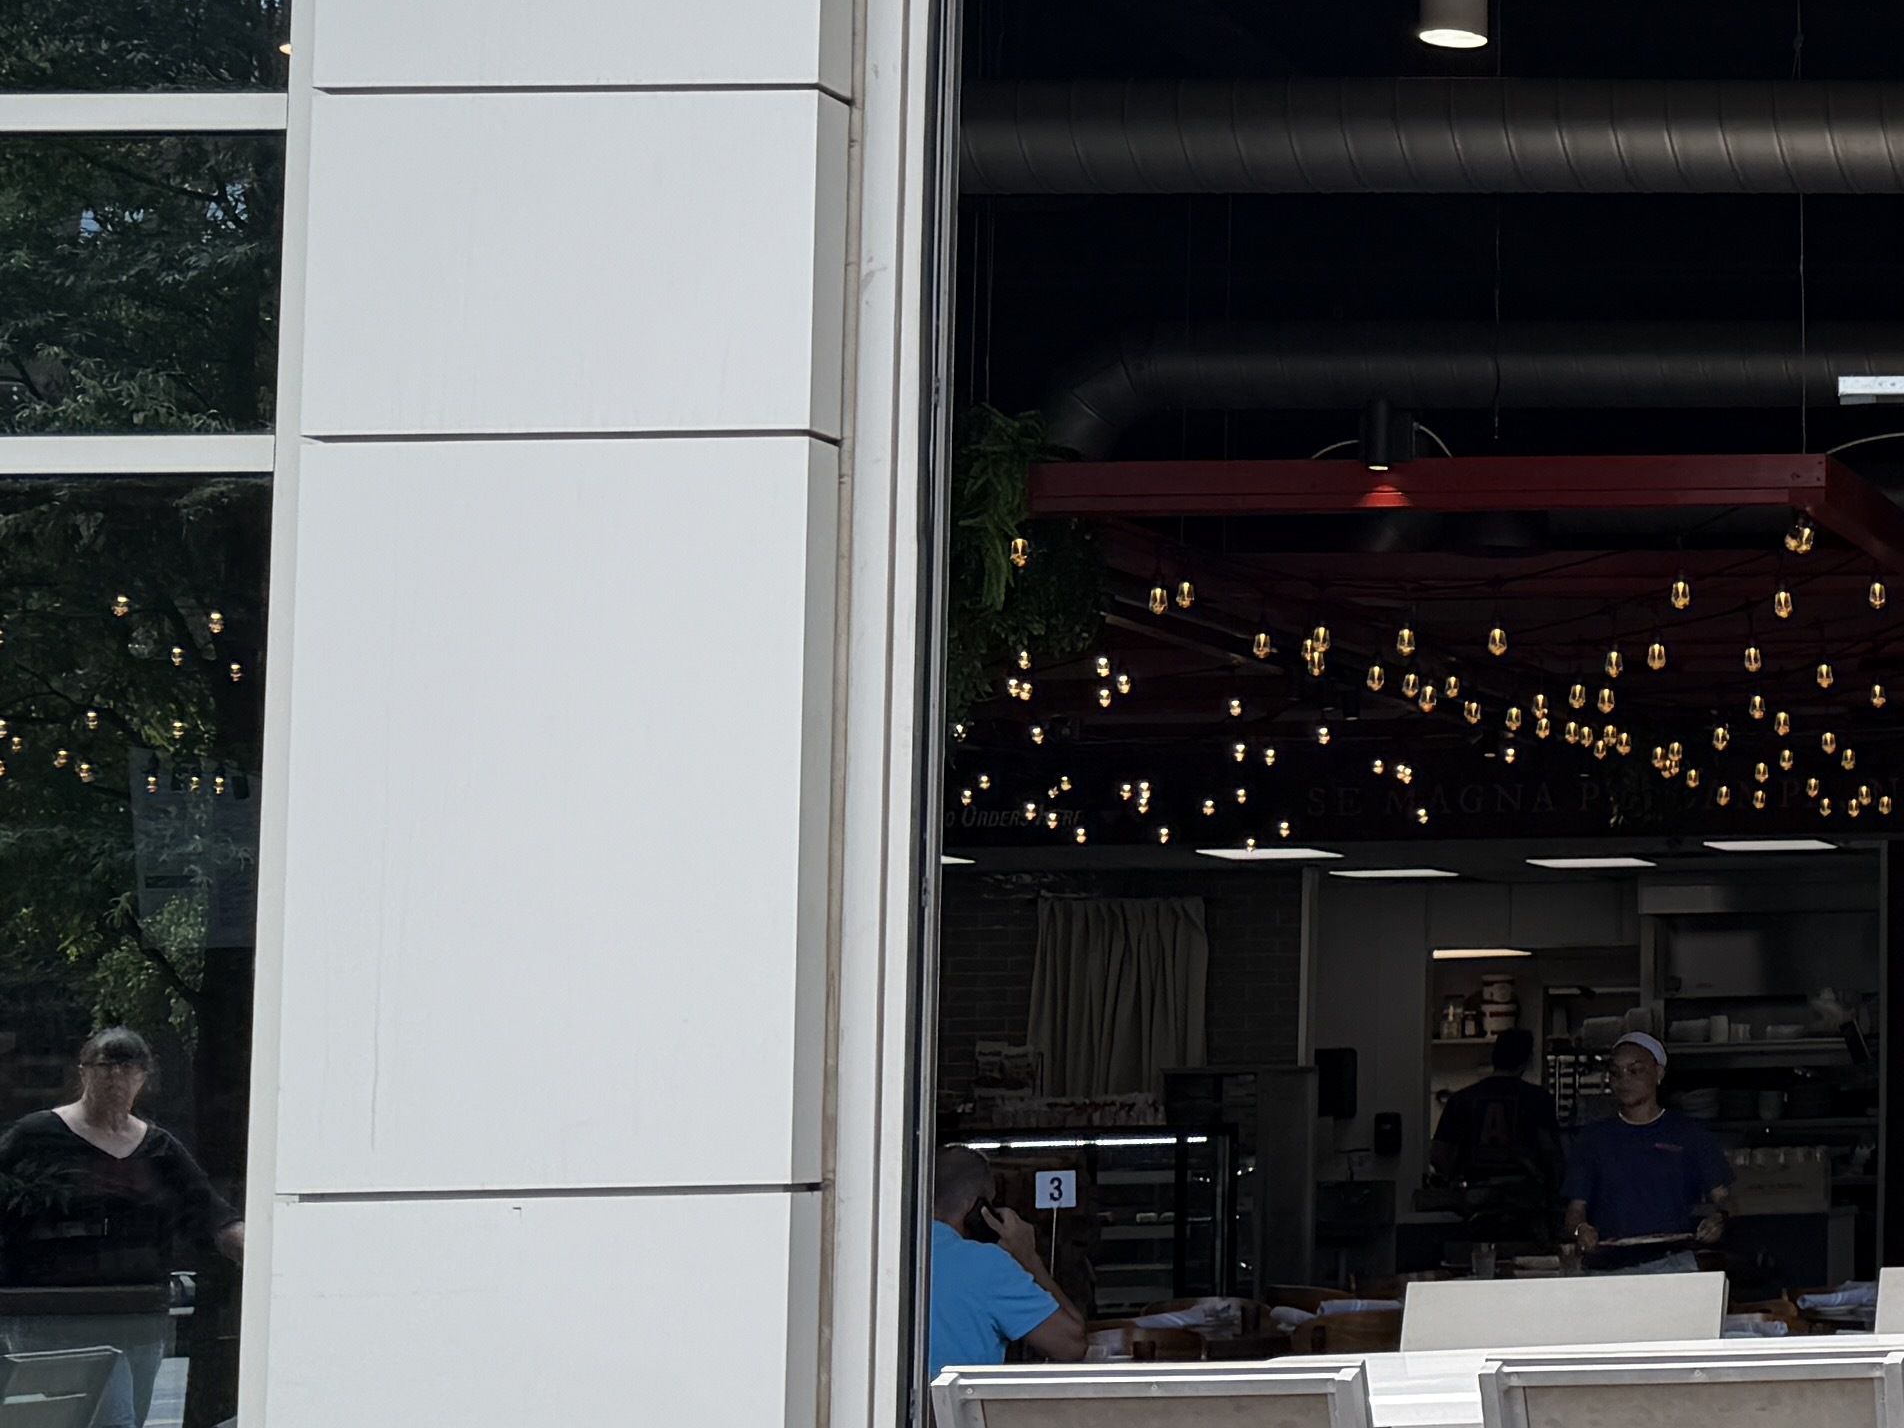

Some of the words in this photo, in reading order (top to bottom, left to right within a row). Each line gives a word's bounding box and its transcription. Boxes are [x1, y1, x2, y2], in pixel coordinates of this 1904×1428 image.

[1306, 786, 1363, 817] SE
[1383, 781, 1556, 816] MAGNA
[1049, 1176, 1063, 1202] 3
